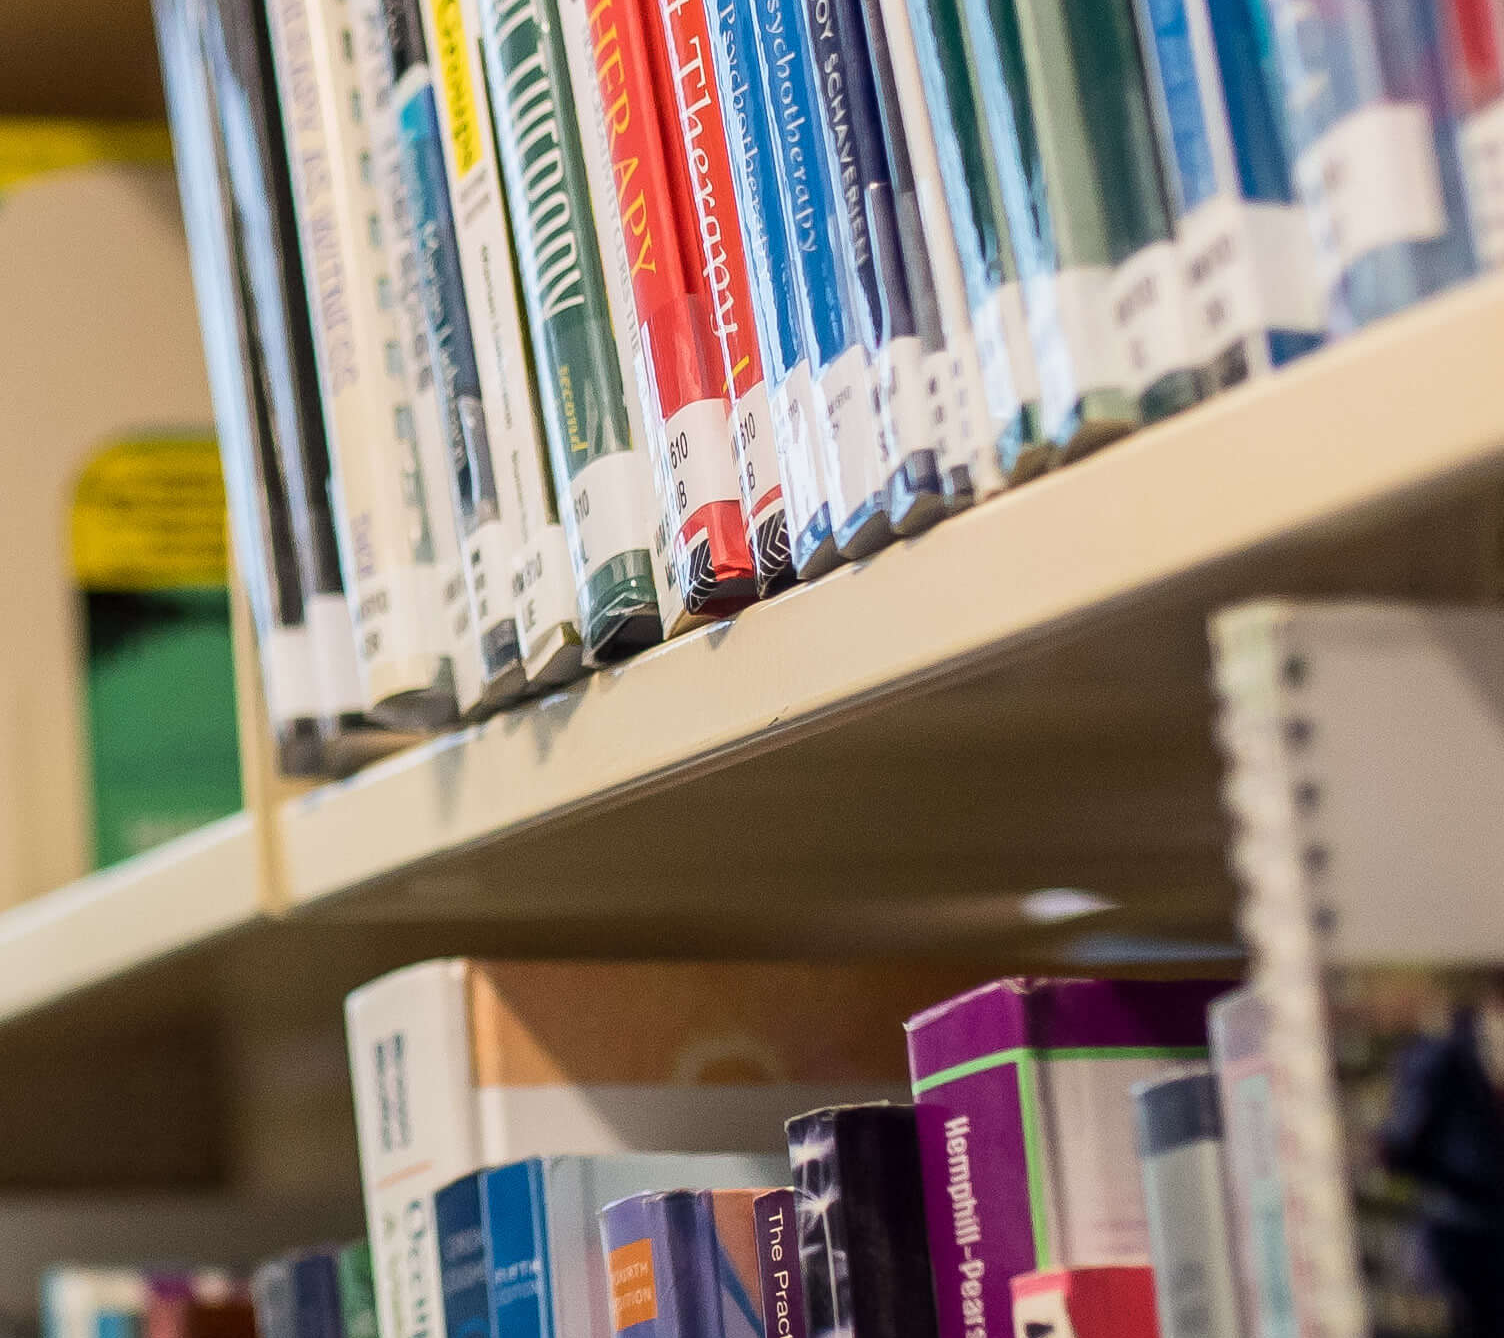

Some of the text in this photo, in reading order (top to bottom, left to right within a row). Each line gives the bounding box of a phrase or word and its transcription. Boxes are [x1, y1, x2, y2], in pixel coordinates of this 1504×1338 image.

[670, 37, 747, 342] Therapy
[670, 432, 689, 470] 610
[764, 1207, 788, 1263] The
